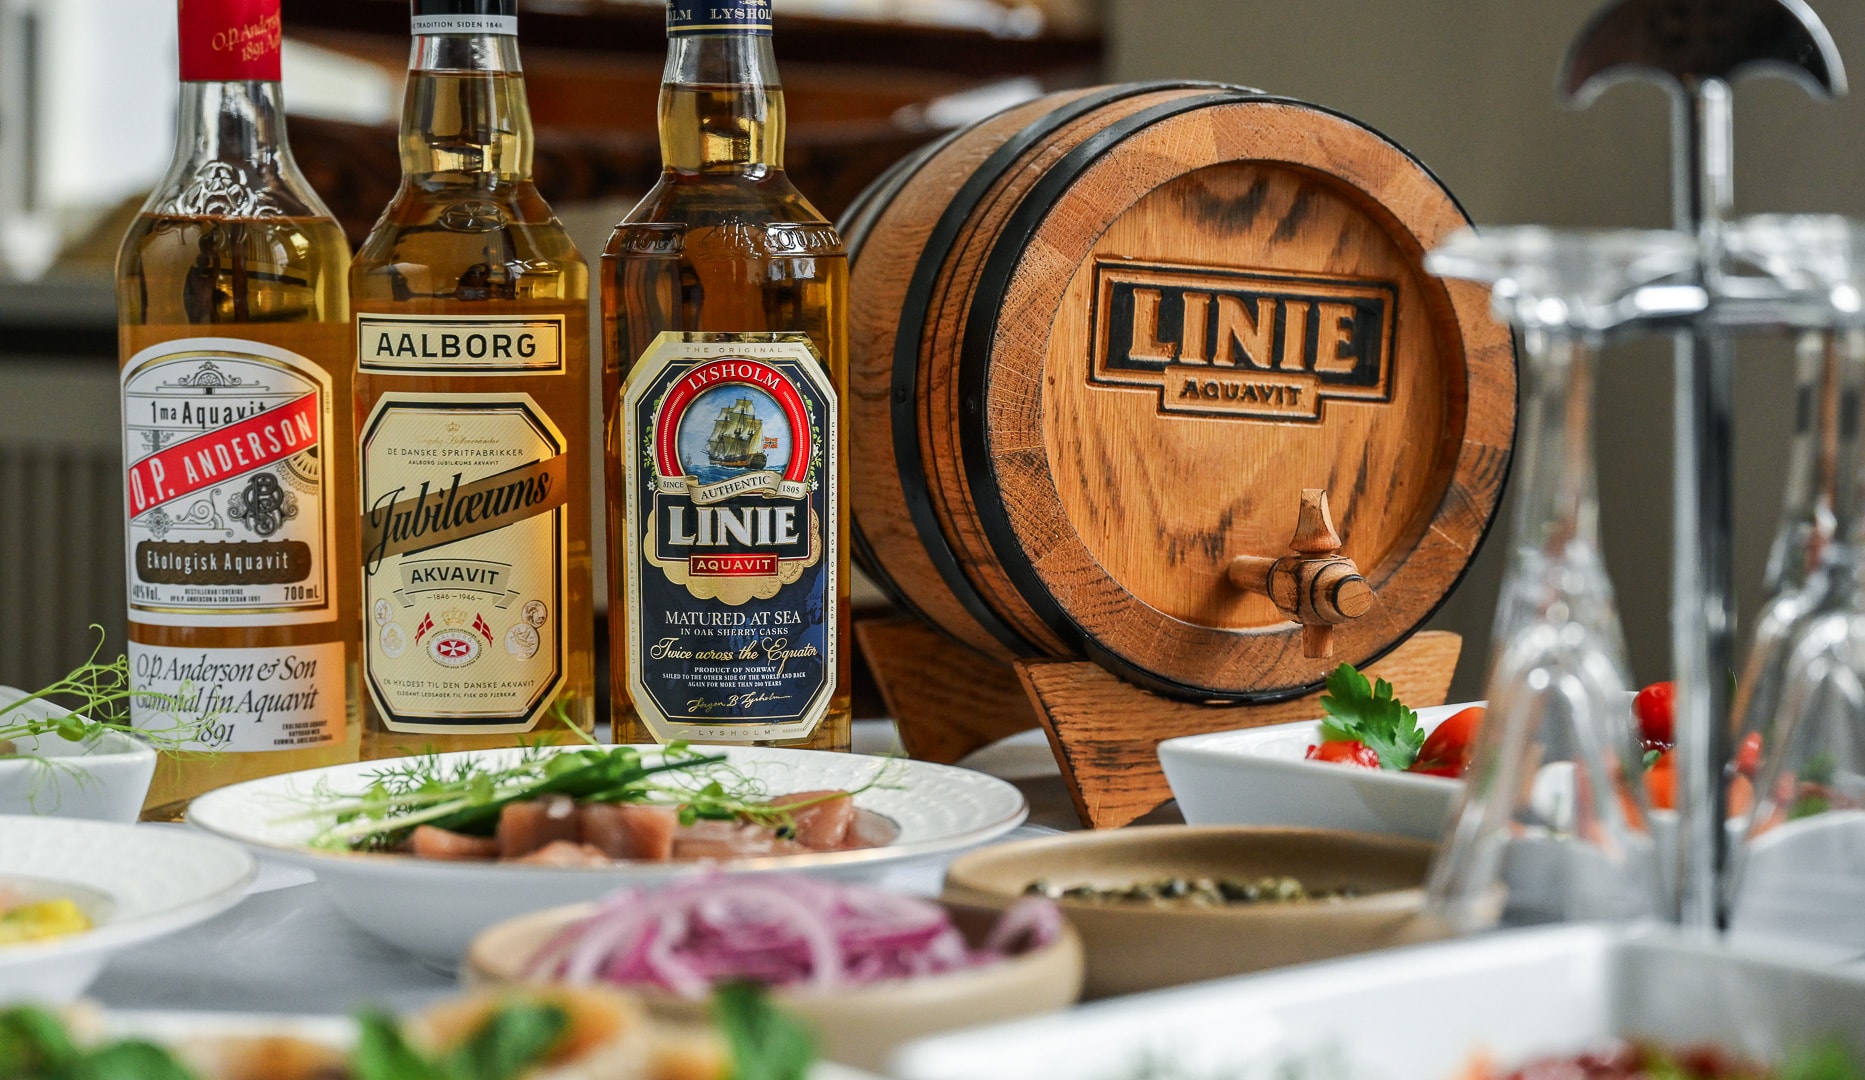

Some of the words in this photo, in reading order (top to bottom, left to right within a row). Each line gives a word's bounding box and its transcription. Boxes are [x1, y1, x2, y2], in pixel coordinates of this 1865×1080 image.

[1128, 288, 1358, 372] LINIE
[376, 332, 536, 359] AALBORG
[688, 364, 780, 391] LYSHOLM
[1179, 379, 1302, 406] AQUAVIT
[151, 401, 177, 424] 1ma
[184, 411, 313, 485] ANDERSON
[387, 448, 398, 456] DE
[442, 449, 524, 457] SPRITFABRIKKER
[701, 475, 771, 500] AUTHENTIC
[782, 482, 800, 494] 1805
[366, 472, 553, 576] Jubilæums
[668, 506, 799, 546] LINIE
[147, 550, 218, 574] Ekologisk
[224, 552, 288, 574] Aquavit
[697, 559, 771, 570] AQUAVIT
[411, 567, 500, 585] AKVAVIT
[459, 593, 476, 601] 1946
[665, 611, 745, 625] MATURED
[750, 613, 770, 625] AT
[775, 611, 801, 624] SEA
[717, 628, 756, 636] SHERRY
[164, 654, 254, 682] Anderson
[279, 655, 317, 680] Son
[650, 637, 692, 660] Twice
[695, 650, 734, 661] across
[738, 640, 759, 660] the
[761, 637, 818, 675] Equator
[393, 680, 424, 688] HYLDEST
[235, 684, 319, 722] Aquavit
